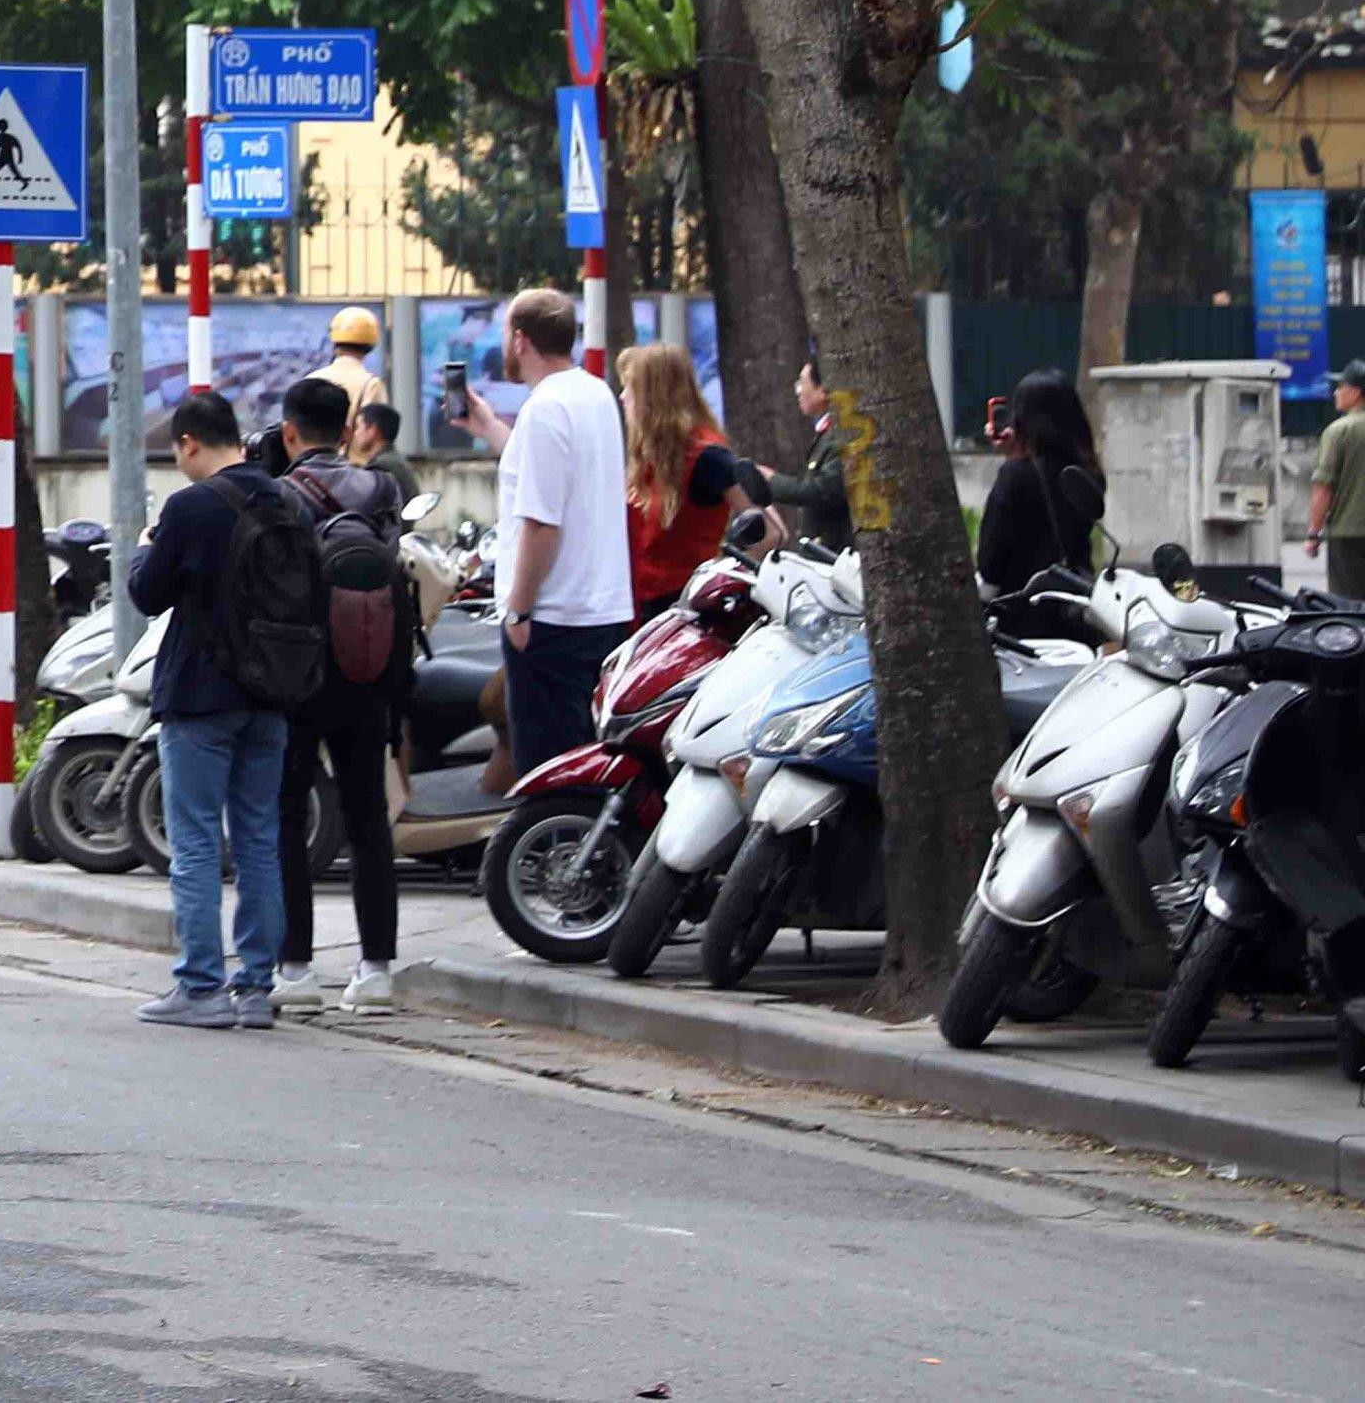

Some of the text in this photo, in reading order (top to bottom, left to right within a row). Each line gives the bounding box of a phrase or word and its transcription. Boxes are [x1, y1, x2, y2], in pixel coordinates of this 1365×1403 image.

[282, 41, 334, 63] PHỐ
[276, 71, 322, 105] HƯNG
[241, 134, 270, 157] PHỐ
